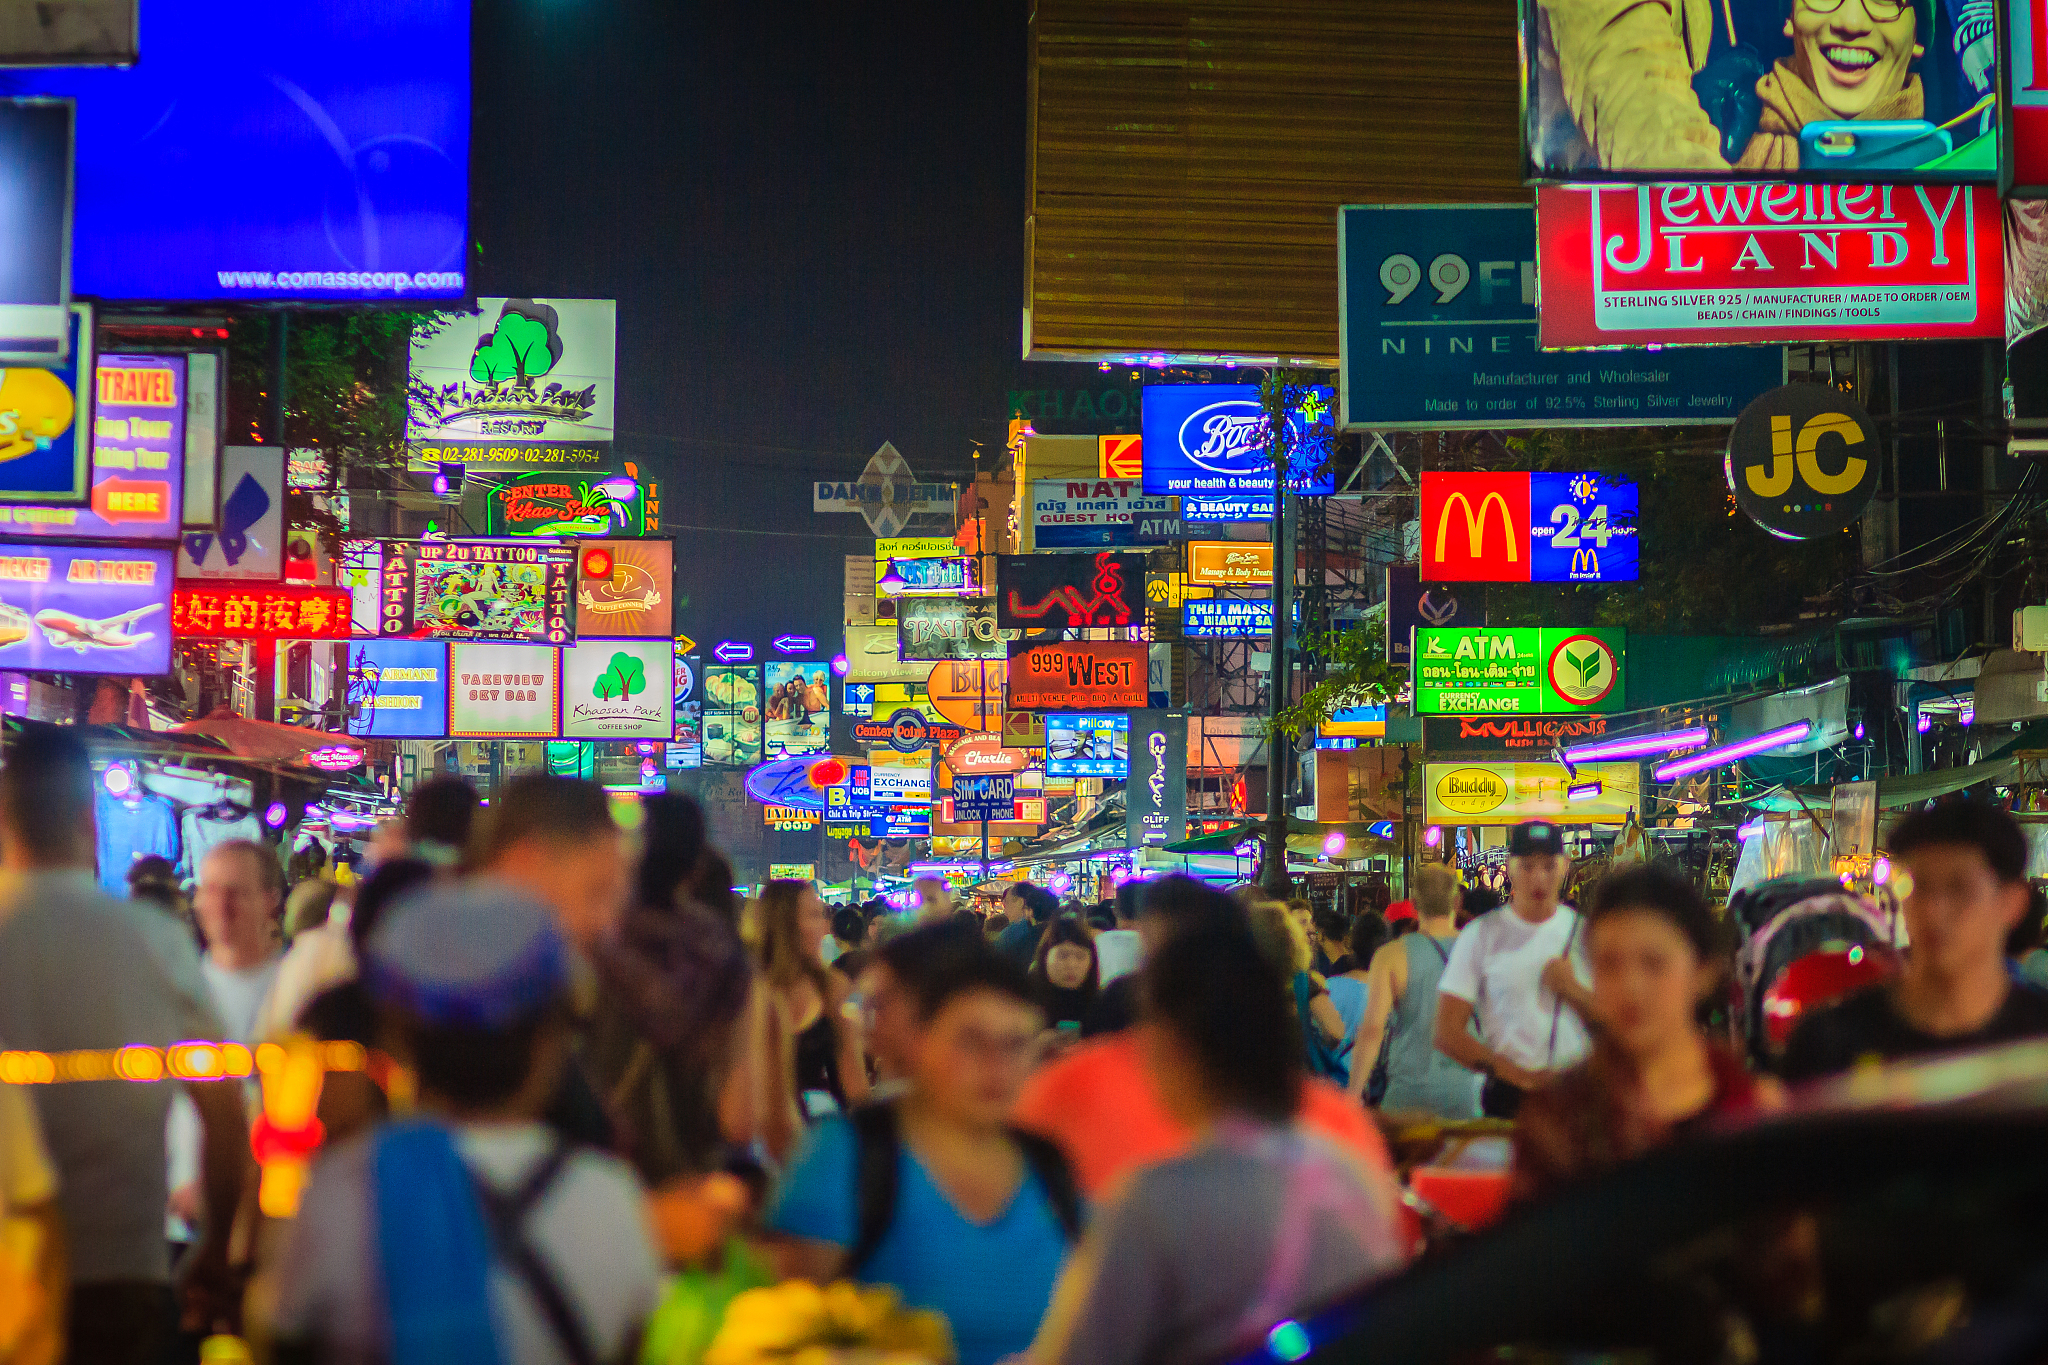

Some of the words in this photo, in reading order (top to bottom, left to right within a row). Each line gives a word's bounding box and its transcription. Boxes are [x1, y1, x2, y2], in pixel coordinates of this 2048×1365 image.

[1664, 231, 1909, 272] LAND
[217, 268, 464, 291] www.comasscorp.com
[1604, 296, 1668, 308] STERLING
[1671, 295, 1715, 307] SILVER
[1718, 294, 1742, 305] 925
[1753, 293, 1842, 305] MANUFACTURER
[1850, 293, 1882, 303] MADE
[1884, 292, 1898, 302] TO
[1901, 292, 1937, 302] ORDER
[1946, 291, 1970, 301] OEM
[1697, 311, 1733, 320] BEADS
[1742, 310, 1776, 320] CHAIN
[1785, 308, 1837, 319] FINDINGS
[1845, 307, 1880, 317] TOOLS
[1473, 371, 1559, 386] Manufacturer
[1567, 370, 1591, 385] and
[1600, 369, 1671, 384] Wholesaler
[99, 370, 173, 404] TRAVEL
[1425, 398, 1459, 412] Made
[1466, 397, 1478, 410] to
[1486, 396, 1517, 410] order
[1526, 396, 1538, 409] of
[1545, 395, 1586, 409] 92.5%
[1594, 394, 1639, 410] Sterling
[1647, 393, 1680, 407] Silver
[1687, 394, 1733, 410] Jewelry
[479, 422, 542, 436] RESORT
[1745, 412, 1868, 498] JC
[1066, 481, 1134, 499] NAT
[1168, 479, 1192, 489] your
[1194, 477, 1226, 489] health
[1228, 478, 1237, 488] &
[1239, 477, 1274, 490] beauty
[107, 491, 160, 513] HERE
[1186, 503, 1197, 512] &
[1200, 503, 1250, 512] BEAUTY
[1040, 513, 1098, 523] GUEST
[1139, 519, 1180, 535] ATM
[1531, 526, 1555, 538] open
[1551, 504, 1613, 549] 24
[420, 546, 442, 559] UP
[473, 546, 538, 562] TATTOO
[98, 560, 157, 585] TICKET
[1200, 567, 1227, 578] Massage
[548, 562, 570, 643] TATTOO
[595, 602, 618, 611] COFFEE
[1188, 604, 1222, 615] THAI
[1188, 616, 1199, 626] &
[1204, 616, 1250, 626] BEAUTY
[1454, 635, 1517, 660] ATM
[1031, 653, 1063, 673] 999
[380, 668, 437, 681] ARMANI
[461, 673, 545, 686] TAKEVIEW
[852, 668, 889, 679] Balcony
[890, 668, 912, 676] View
[915, 667, 924, 675] &
[469, 690, 500, 701] SKY
[505, 690, 537, 701] BAR
[573, 703, 629, 718] Khaosan
[633, 704, 662, 718] Park
[1439, 698, 1520, 711] EXCHANGE
[1079, 717, 1115, 729] Pillow
[855, 725, 894, 738] Center
[896, 725, 927, 738] Point
[929, 726, 960, 739] Plaza
[974, 734, 987, 742] AND
[1505, 739, 1534, 748] IRISH
[964, 750, 1012, 766] Charlie
[852, 787, 870, 795] UOB
[953, 779, 975, 801] SIM
[979, 778, 1014, 800] CARD
[1449, 776, 1497, 797] Buddy
[1450, 799, 1495, 809] Lodge
[954, 809, 981, 820] UNLOCK
[991, 808, 1014, 820] PHONE
[1142, 815, 1170, 824] CLIFF
[774, 821, 813, 831] FOOD
